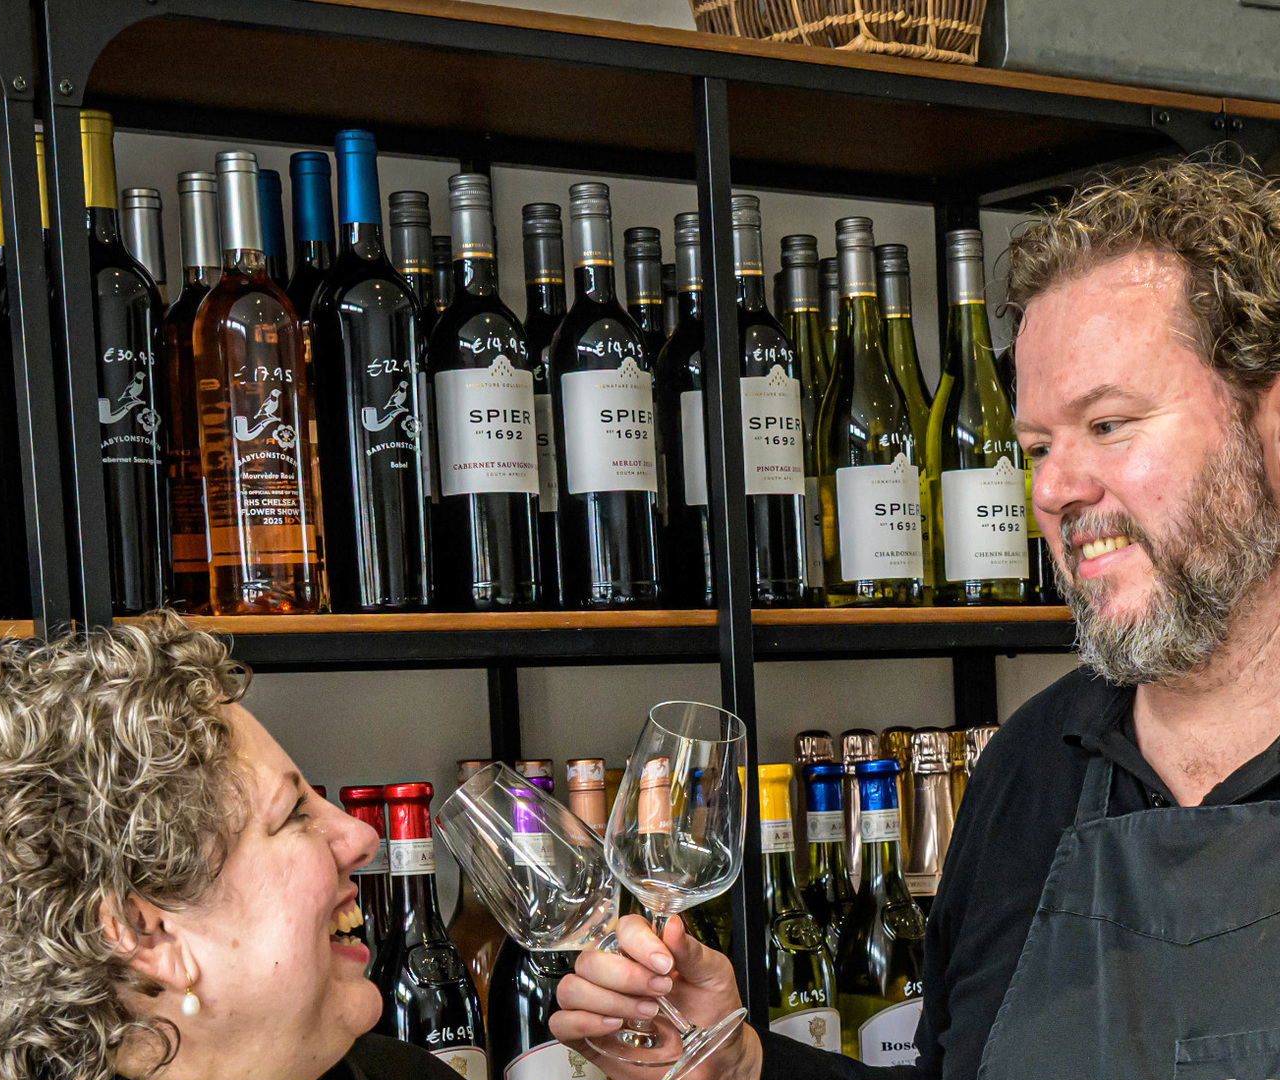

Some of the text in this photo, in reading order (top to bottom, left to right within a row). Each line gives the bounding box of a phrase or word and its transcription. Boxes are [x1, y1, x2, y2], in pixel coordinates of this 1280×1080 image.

[469, 408, 532, 425] SPIER
[600, 408, 655, 425] SPIER
[748, 415, 802, 431] SPIER
[486, 430, 524, 441] 1692
[615, 430, 649, 441] 1692
[764, 435, 796, 447] 1692
[390, 461, 409, 470] Babel
[453, 461, 496, 471] CABERNET
[611, 459, 643, 467] MERLOT
[756, 464, 791, 474] PINOTAGE
[243, 498, 297, 507] RHS CHELSEA
[240, 507, 300, 516] FLOWER SHOW
[874, 502, 921, 517] SPIER
[976, 503, 1026, 518] SPIER
[263, 517, 283, 525] 2025
[888, 520, 918, 533] 1692
[990, 521, 1021, 533] 1692
[974, 550, 1000, 559] CHENIN
